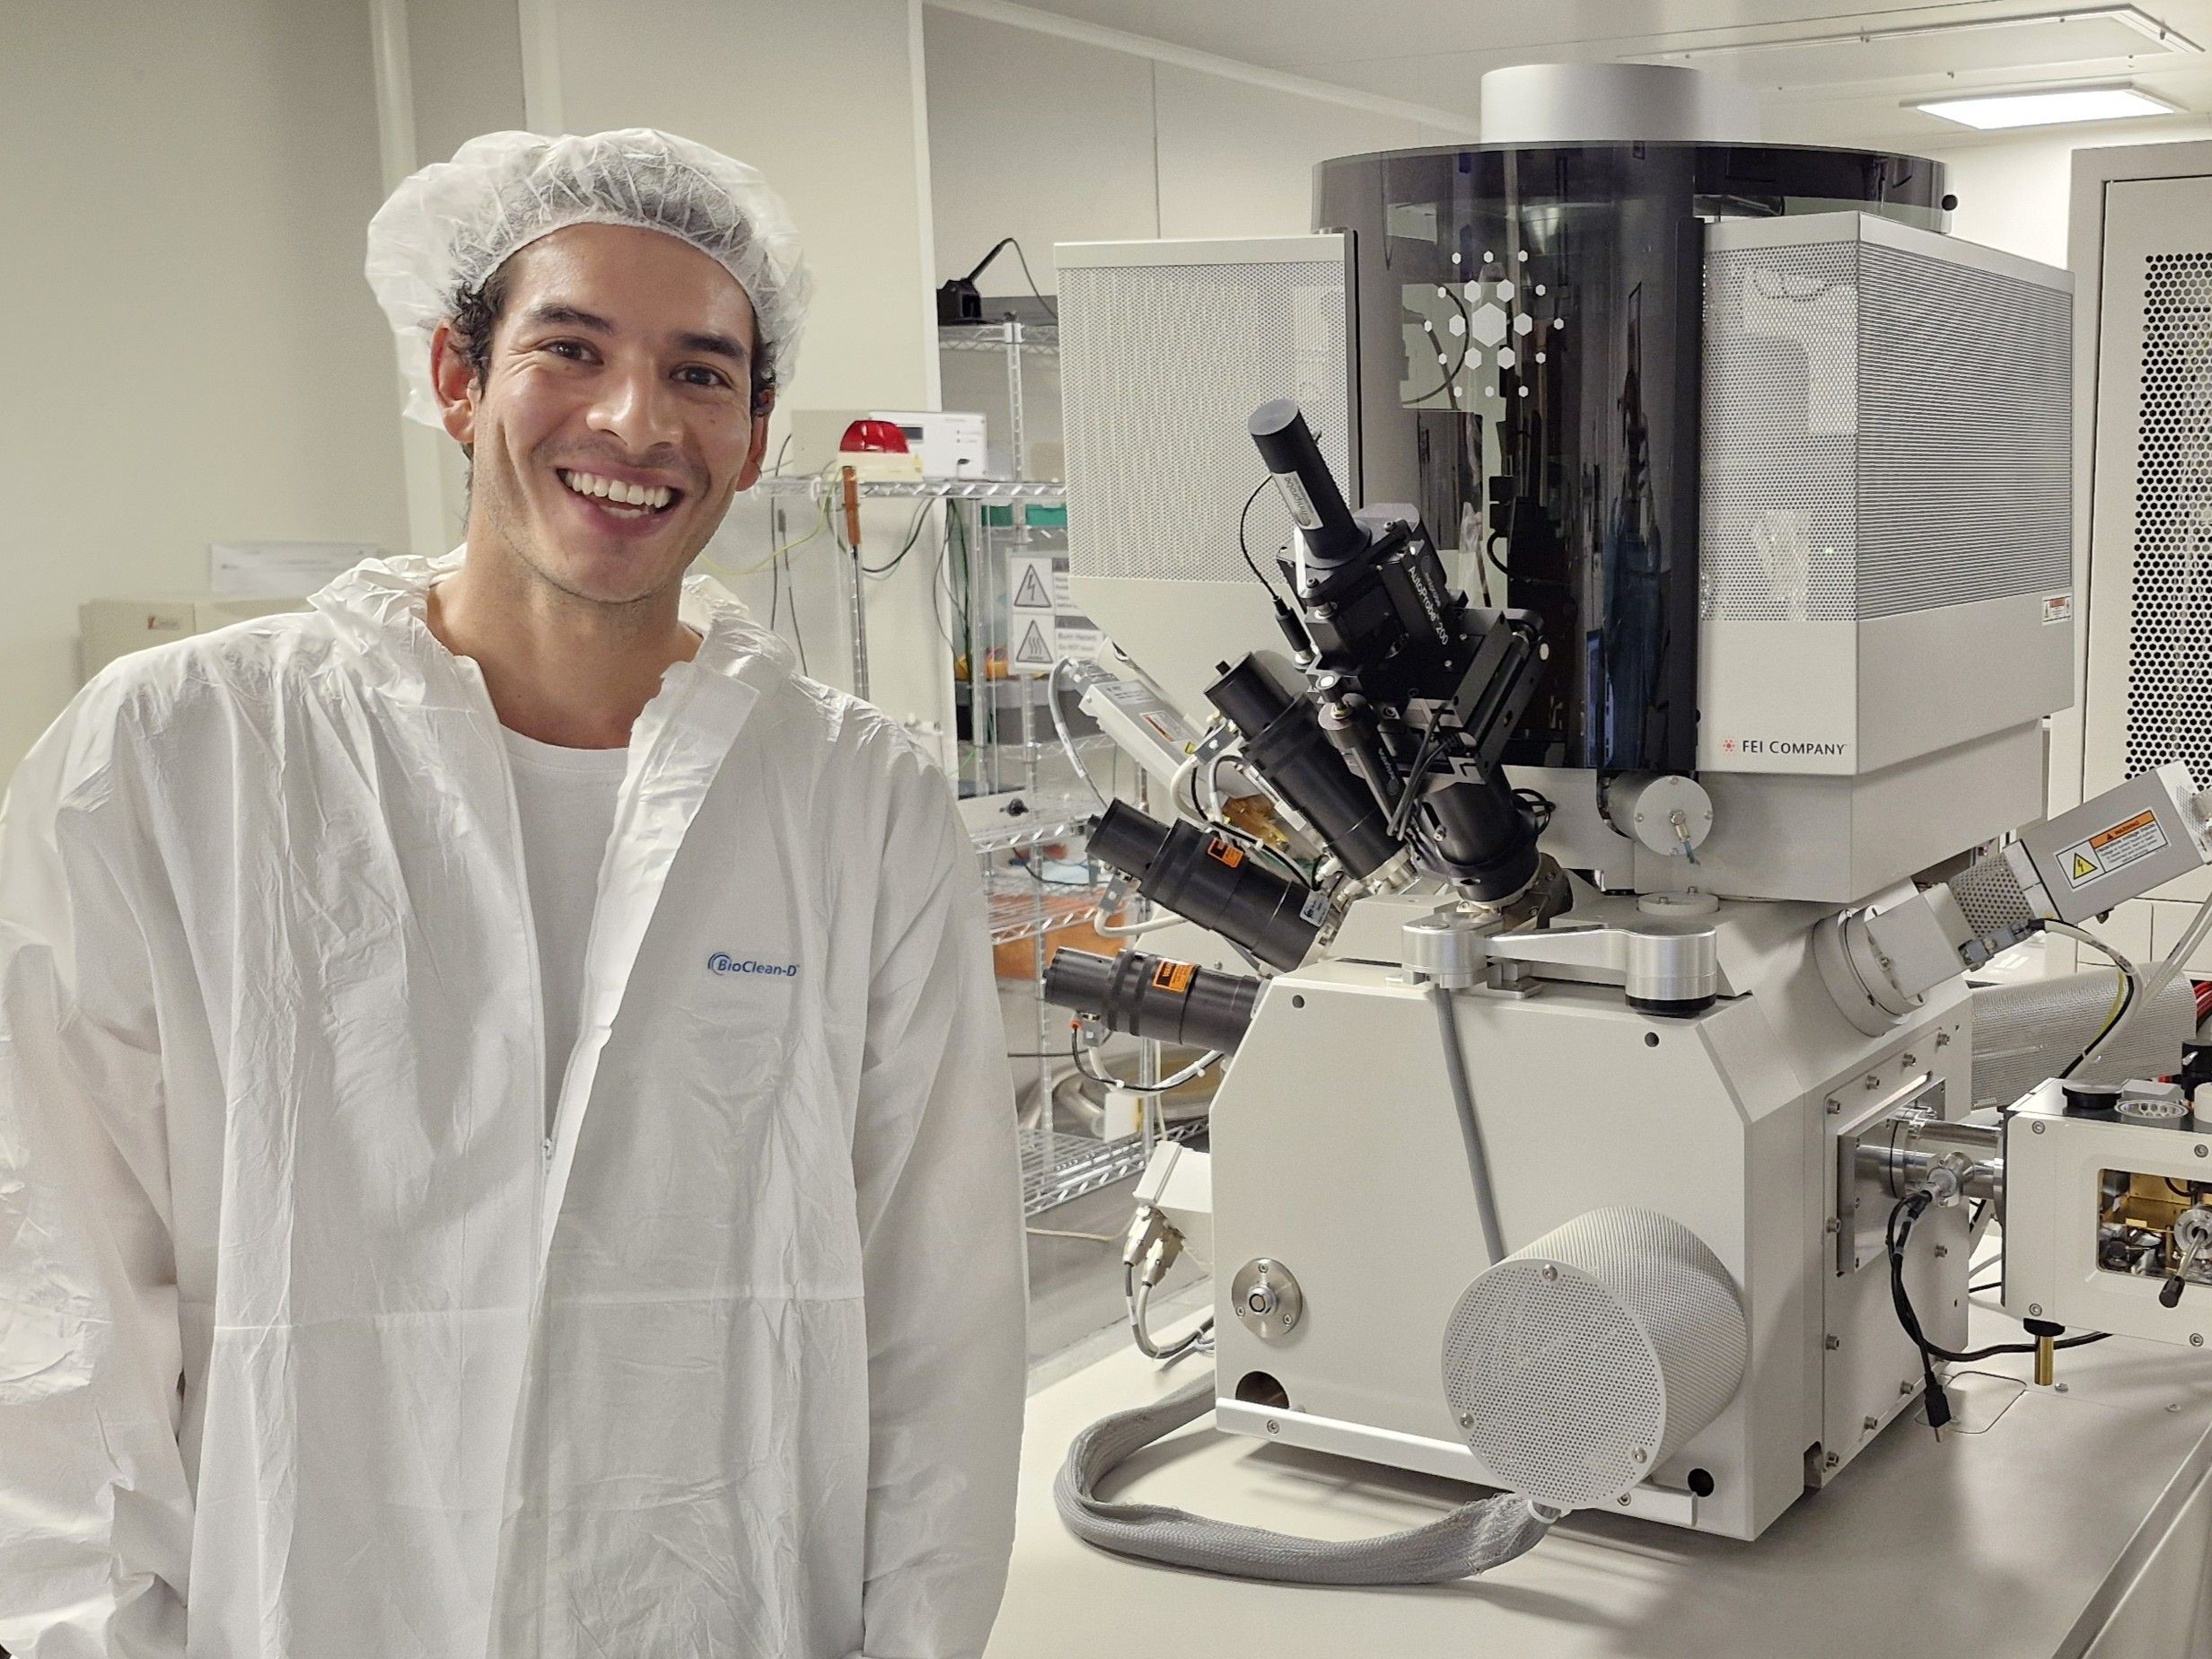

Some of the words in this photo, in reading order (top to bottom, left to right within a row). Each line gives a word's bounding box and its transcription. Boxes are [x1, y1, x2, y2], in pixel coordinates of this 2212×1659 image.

[1436, 622, 1448, 645] 200
[1742, 740, 1763, 753] FEI
[1769, 741, 1846, 755] COMPANY
[716, 957, 797, 977] BioClean-D
